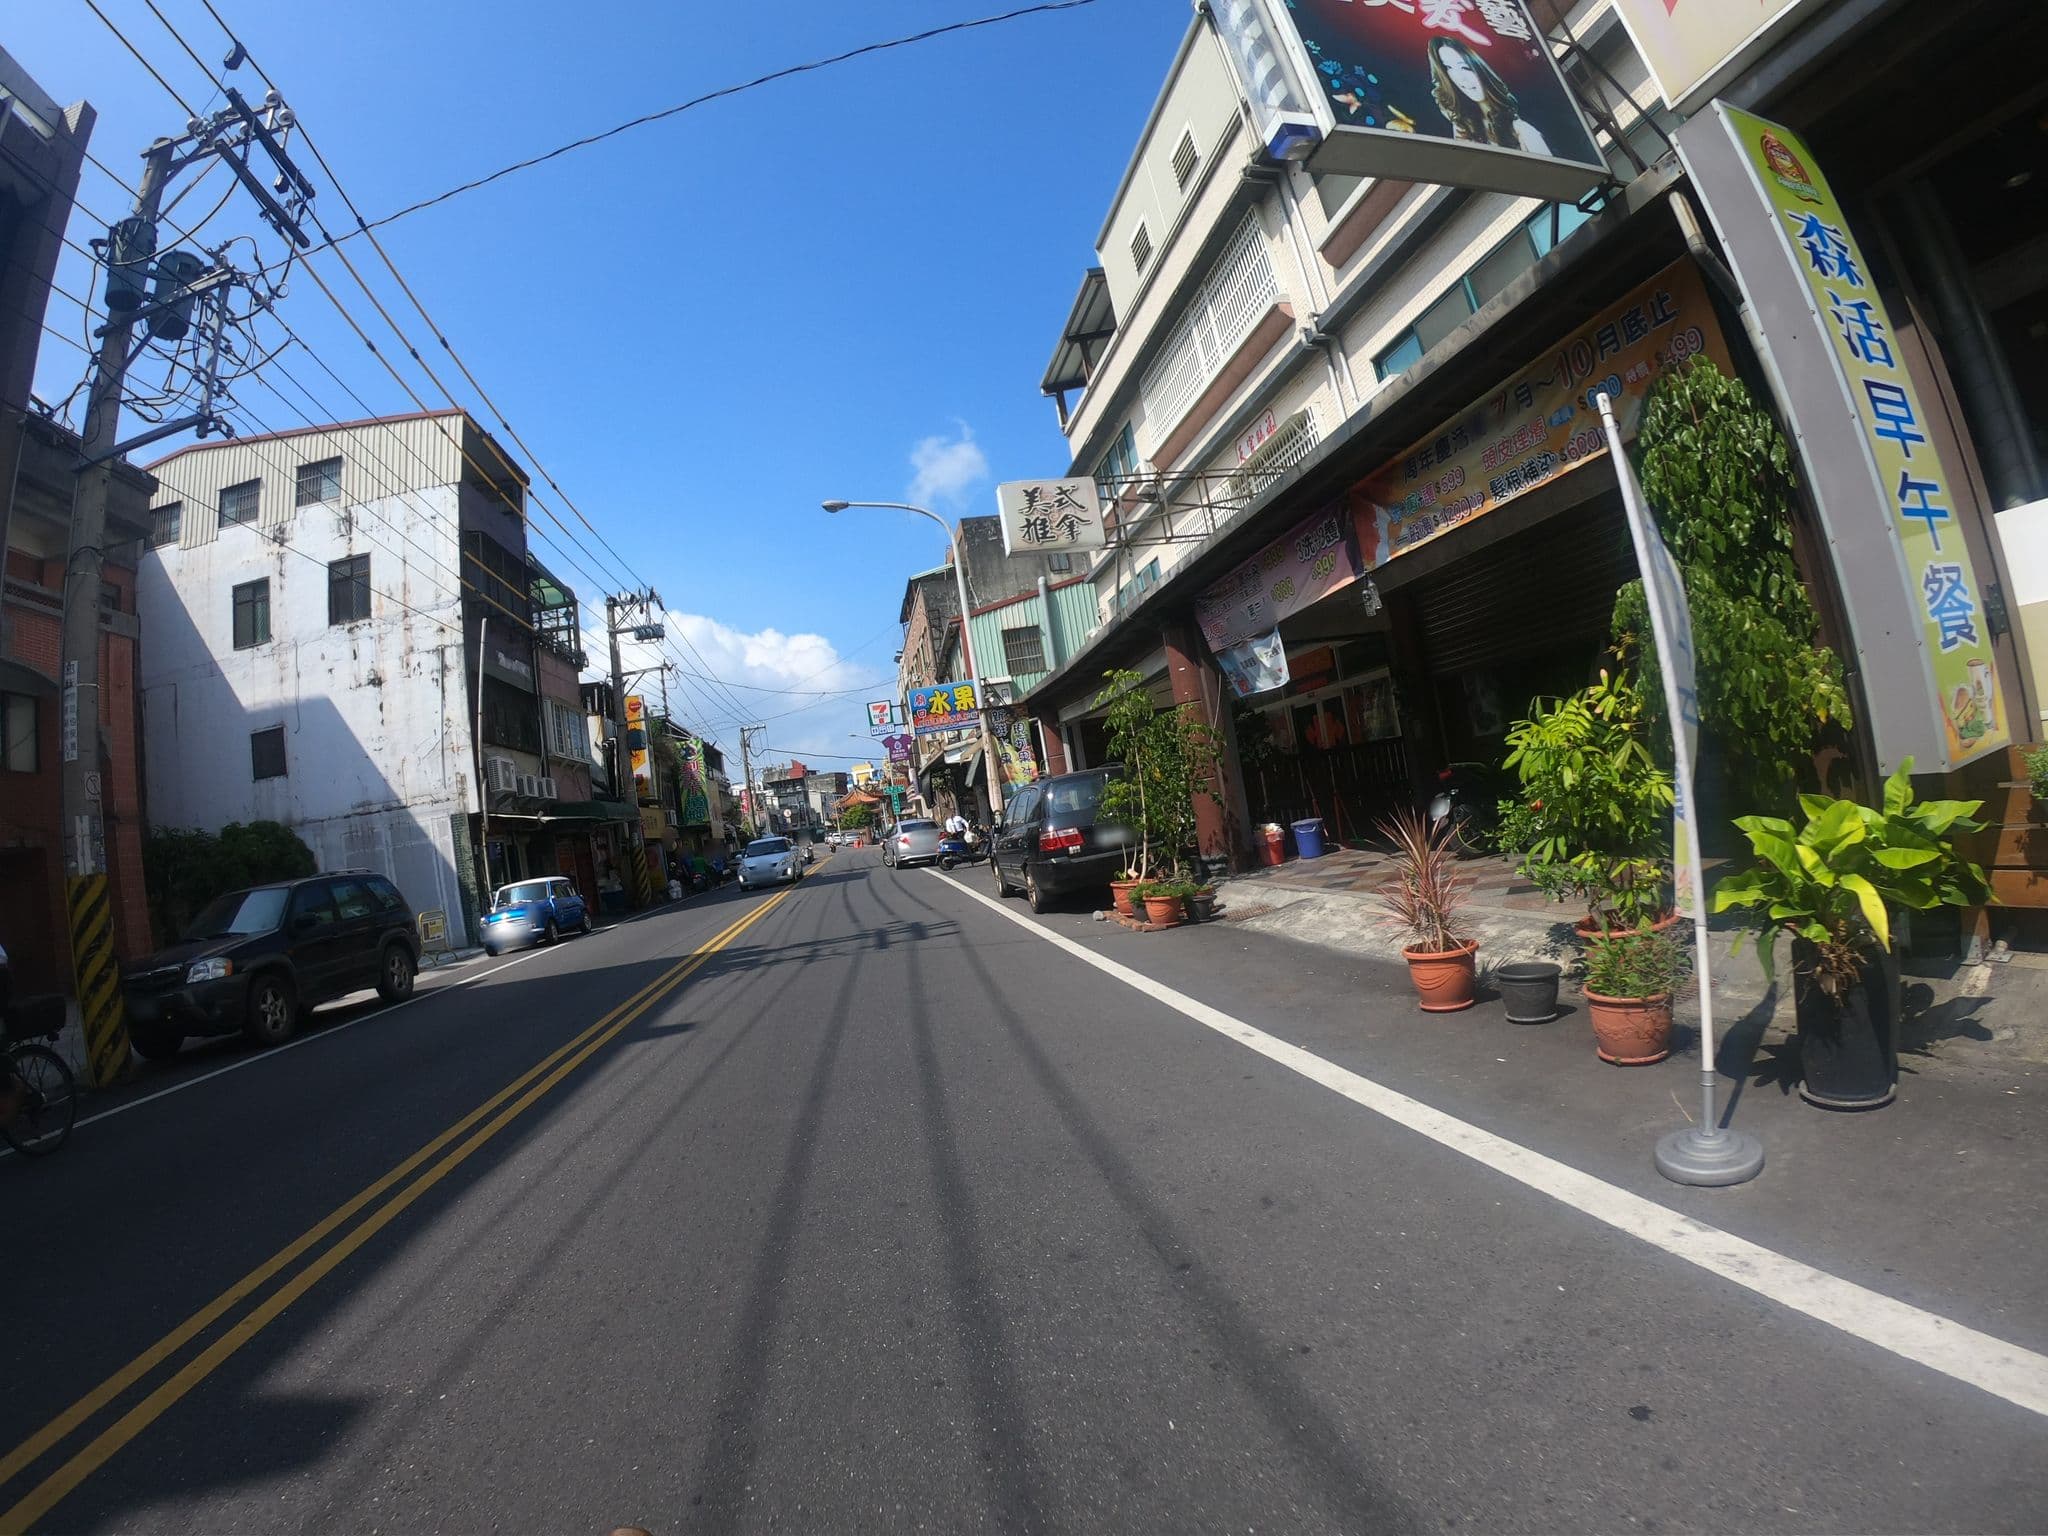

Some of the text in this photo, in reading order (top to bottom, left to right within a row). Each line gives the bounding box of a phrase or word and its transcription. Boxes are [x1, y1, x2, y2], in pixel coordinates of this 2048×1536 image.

[1788, 210, 1978, 650] 森活早午餐
[1489, 451, 1558, 503] 髮根補染
[1018, 485, 1087, 515] 美式
[1019, 513, 1092, 543] 推拿
[928, 685, 976, 716] 水果
